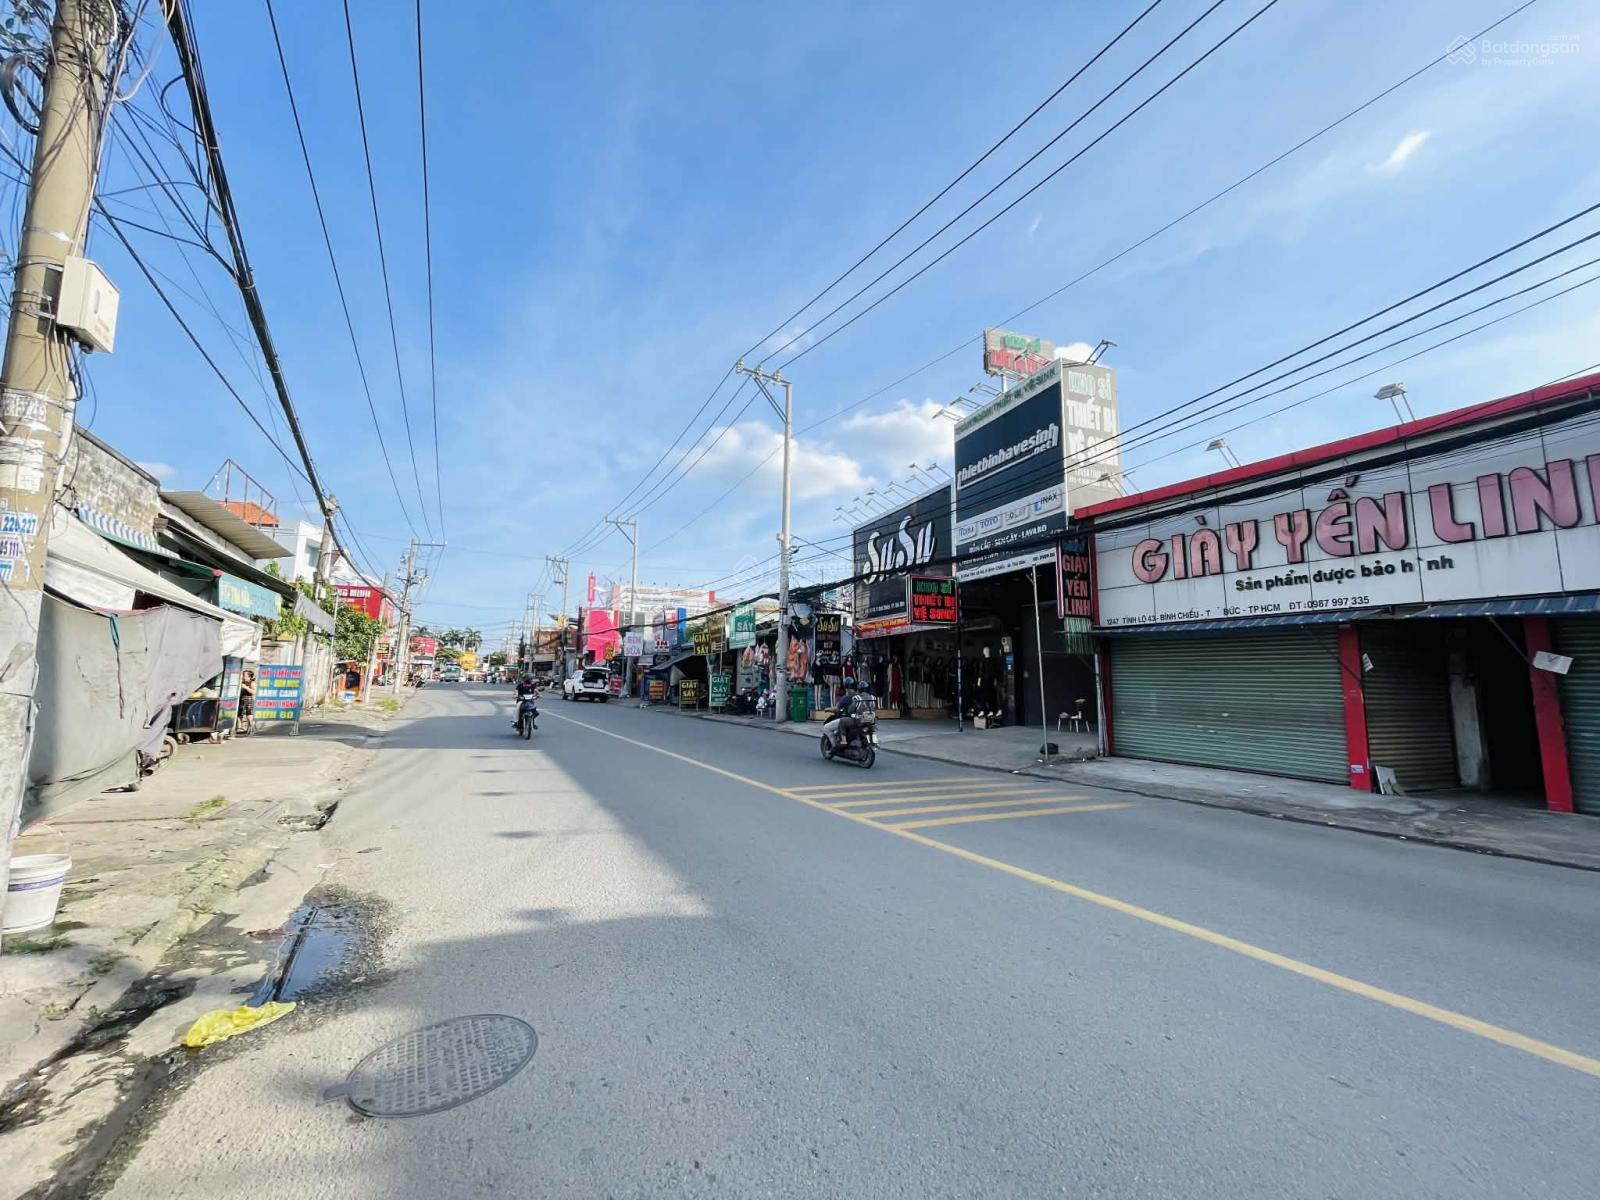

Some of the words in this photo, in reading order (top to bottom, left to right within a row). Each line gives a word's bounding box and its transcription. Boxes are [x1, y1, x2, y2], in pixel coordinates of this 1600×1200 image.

[1131, 515, 1259, 584] GIÀY
[1273, 475, 1409, 564] YẾN
[1235, 577, 1262, 591] Sản
[1266, 569, 1309, 591] phẩm
[1313, 566, 1355, 584] được
[1361, 560, 1395, 577] bảo
[1402, 555, 1454, 573] hnh
[1064, 598, 1091, 616] LINH
[1332, 597, 1349, 607] 997
[1351, 595, 1370, 605] 335
